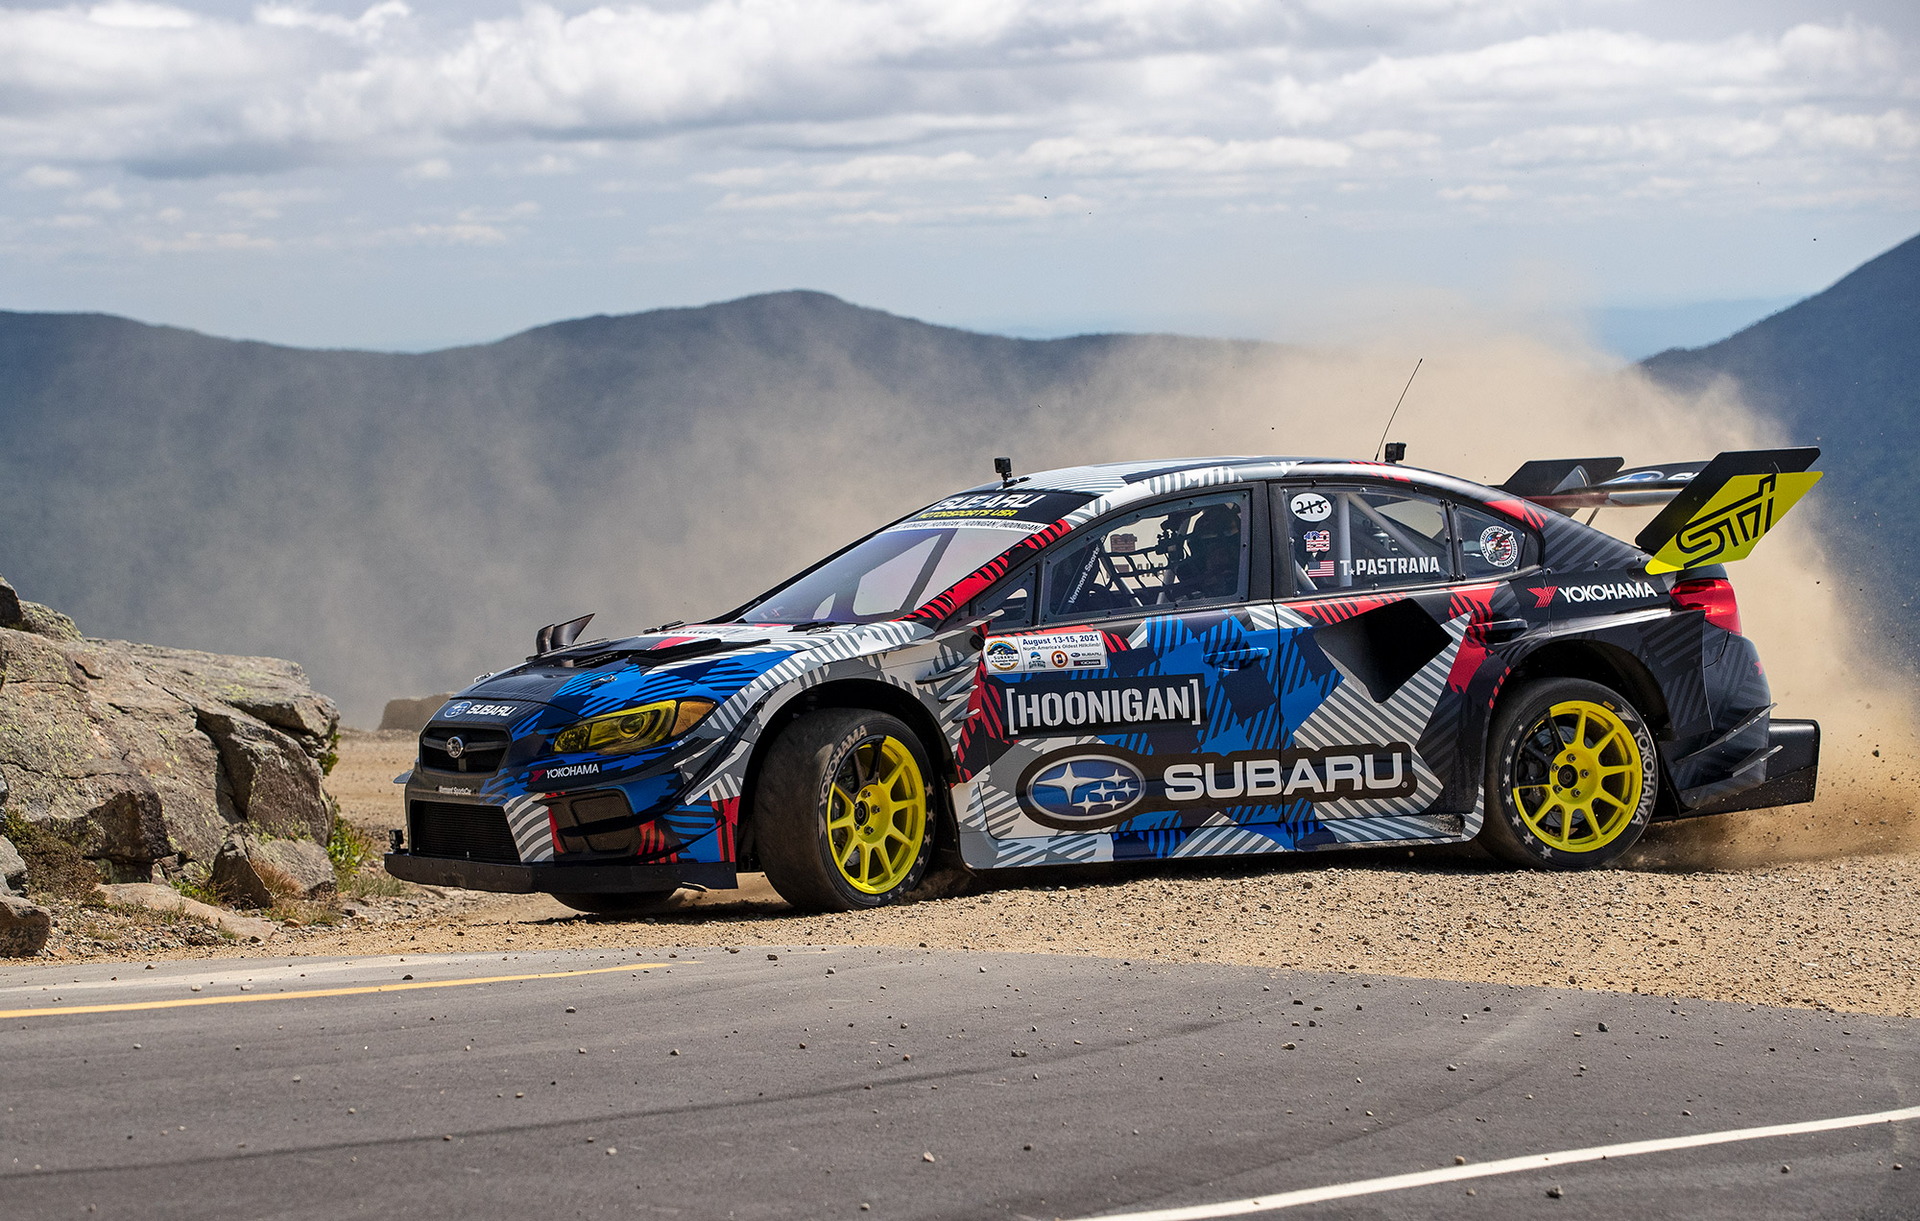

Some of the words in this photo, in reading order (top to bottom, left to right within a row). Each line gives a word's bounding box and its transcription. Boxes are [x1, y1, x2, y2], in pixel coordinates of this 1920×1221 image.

[990, 509, 1018, 517] USA
[1356, 556, 1440, 576] PASTRANA
[1068, 571, 1088, 604] Vermont
[1558, 582, 1658, 603] YOKOHAMA
[1022, 638, 1051, 646] August
[1053, 635, 1078, 643] 13-15,
[1080, 634, 1099, 642] 2021
[466, 704, 518, 717] SUBARU
[546, 763, 600, 779] YOKOHAMA
[819, 724, 867, 807] YOKOHAMA
[1164, 752, 1402, 800] SUBARU
[1631, 727, 1655, 825] YOKOHAMA
